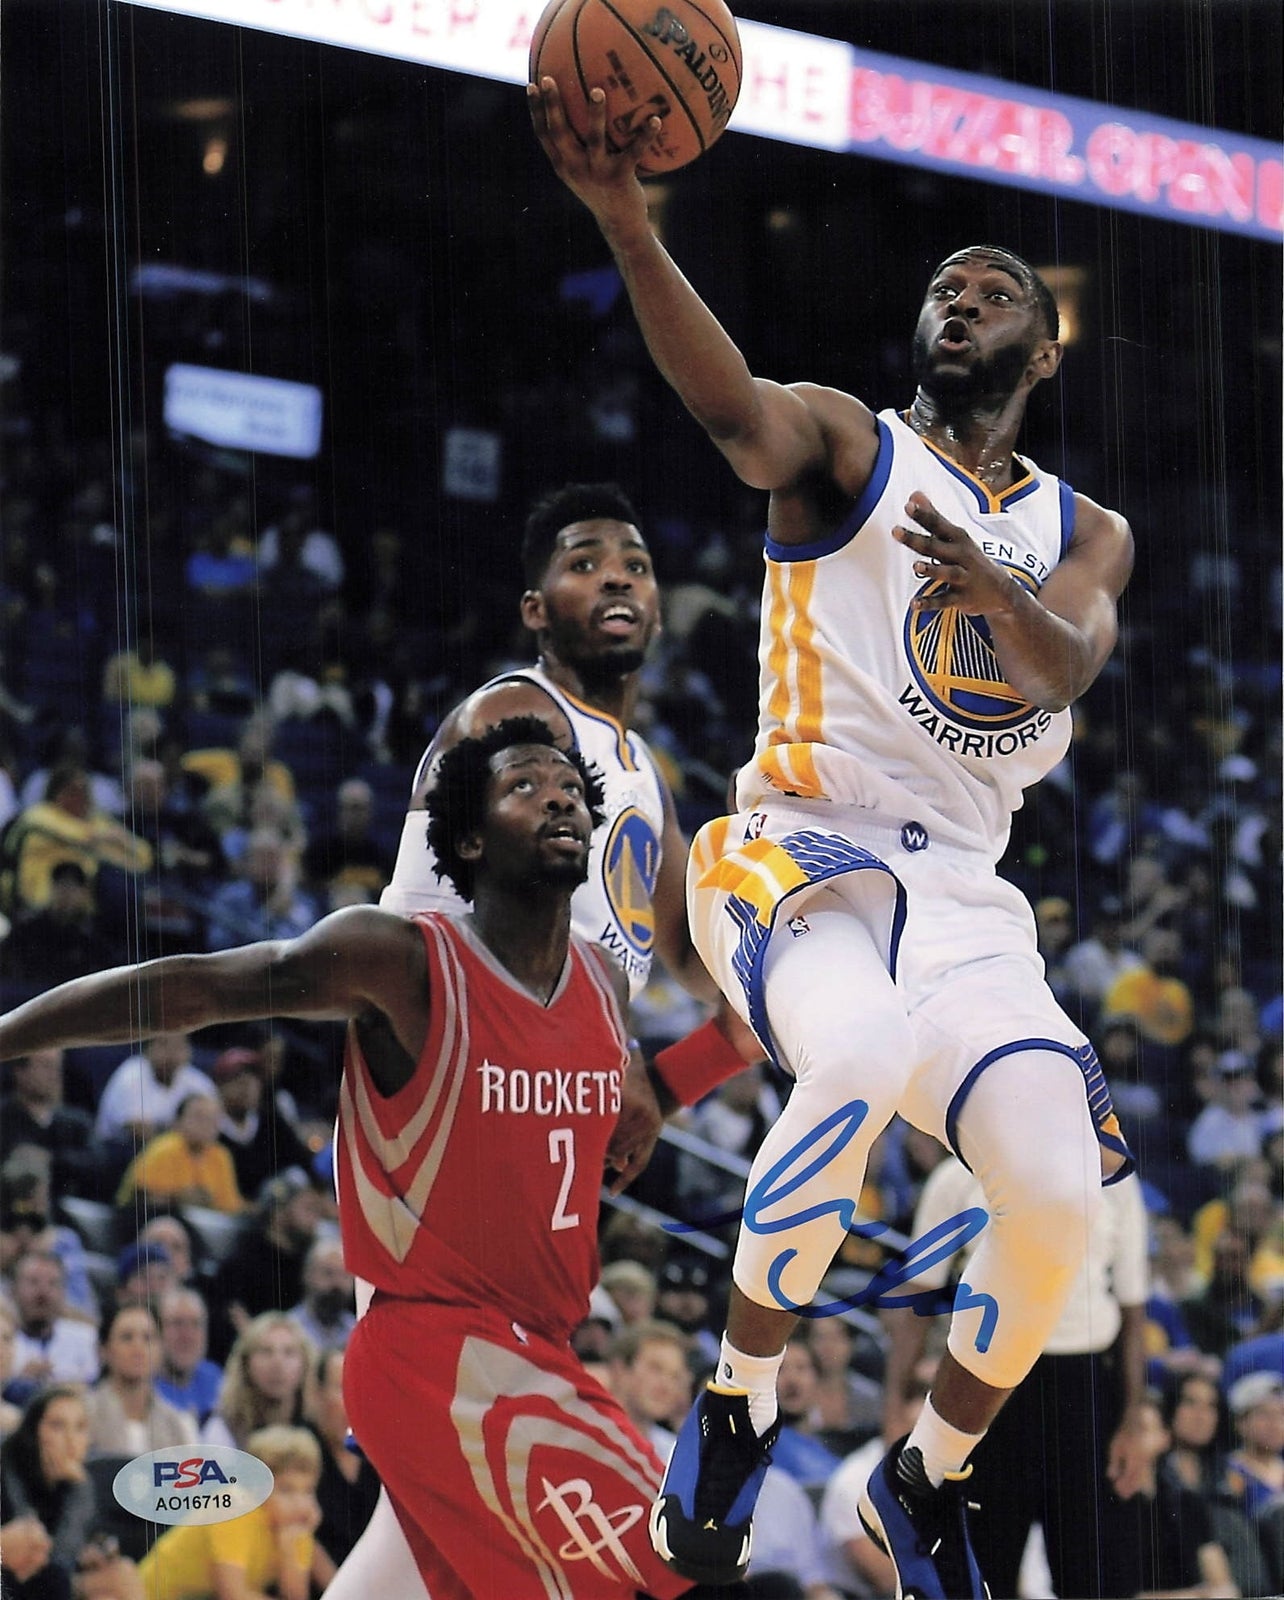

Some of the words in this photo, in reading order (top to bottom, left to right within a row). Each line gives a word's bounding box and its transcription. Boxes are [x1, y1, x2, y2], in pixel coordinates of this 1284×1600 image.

[898, 683, 1052, 758] WARRIORS
[476, 1058, 621, 1117] ROCKETS
[548, 1128, 580, 1231] 2
[153, 1458, 229, 1488] PSA
